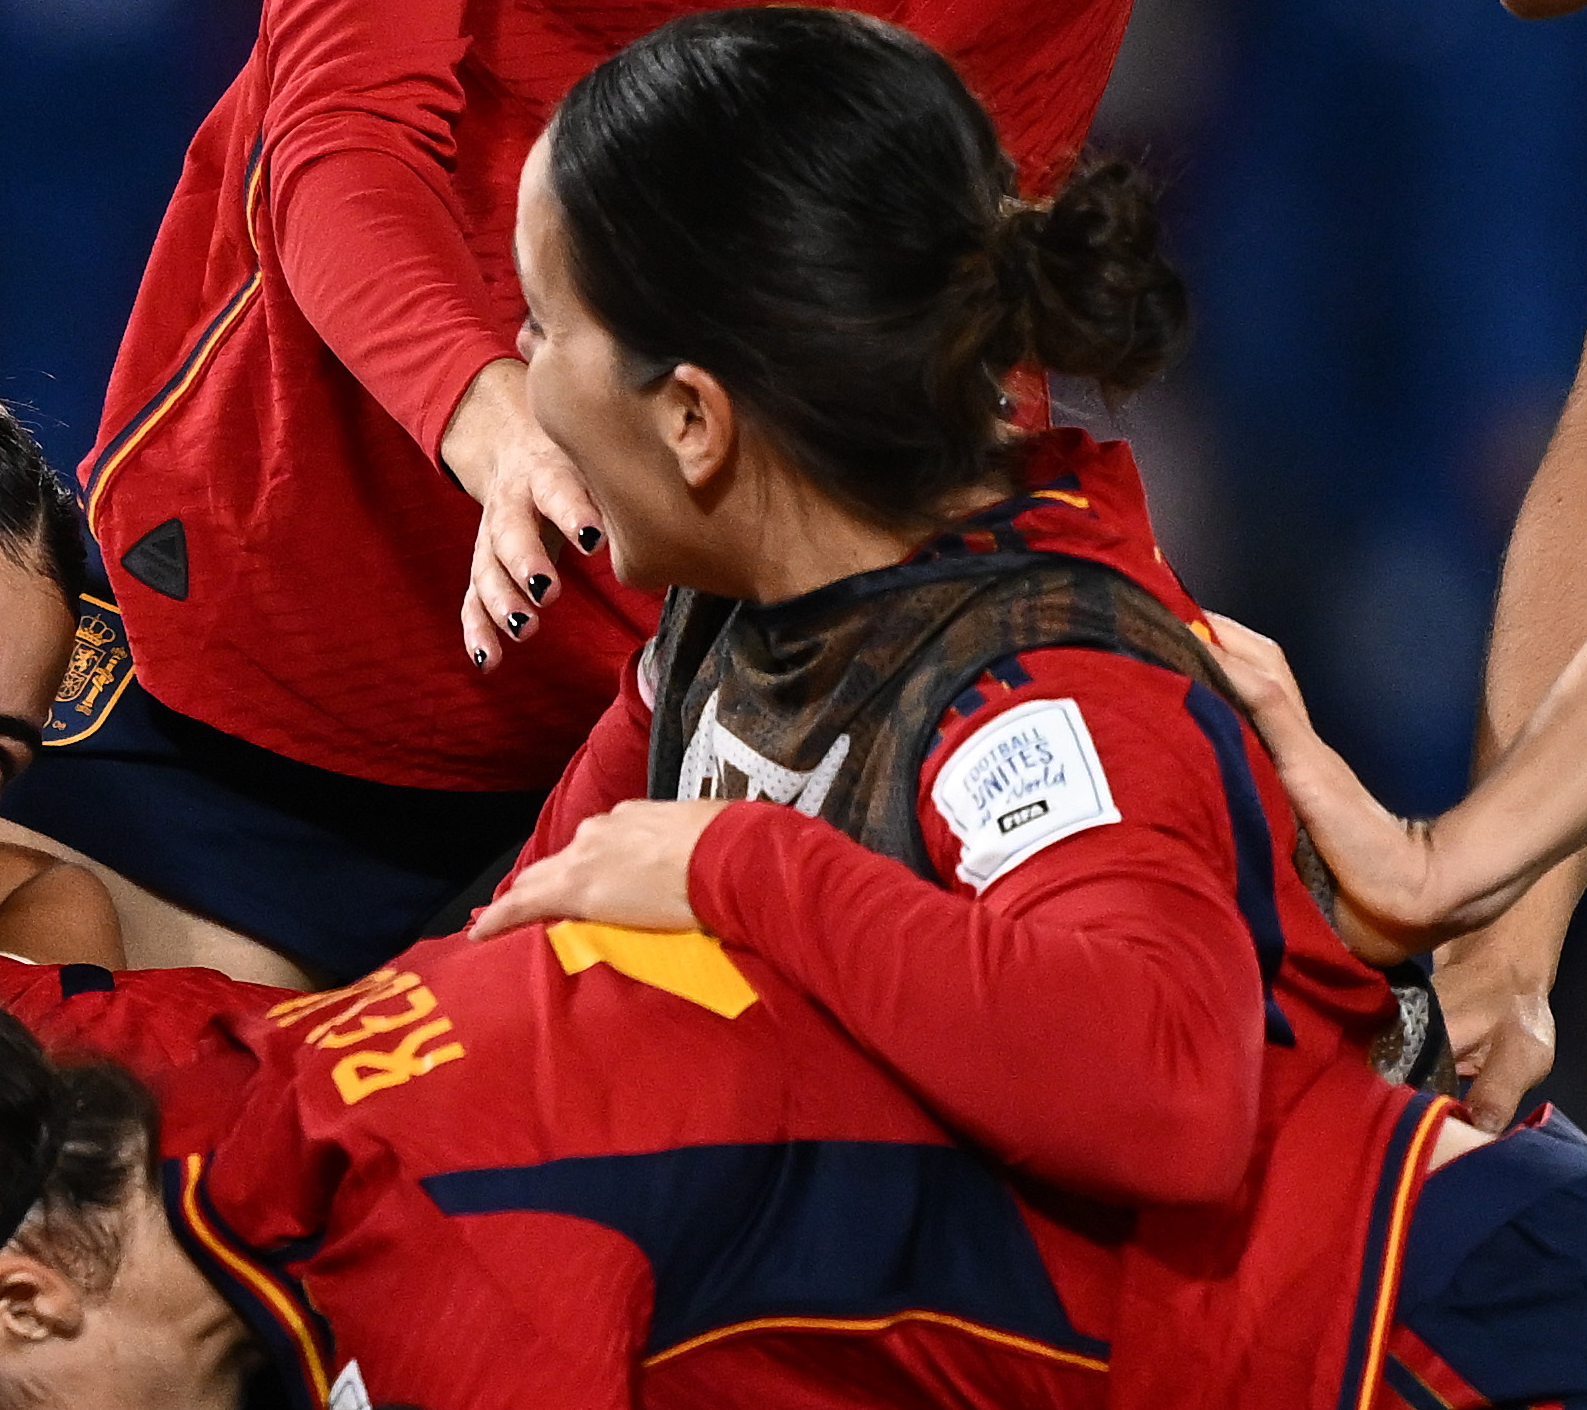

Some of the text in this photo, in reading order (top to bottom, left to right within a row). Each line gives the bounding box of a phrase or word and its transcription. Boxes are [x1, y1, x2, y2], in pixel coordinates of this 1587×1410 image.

[963, 727, 1048, 793] FOOTBALL
[972, 743, 1054, 810] UNITES
[1001, 803, 1046, 831] FIFA
